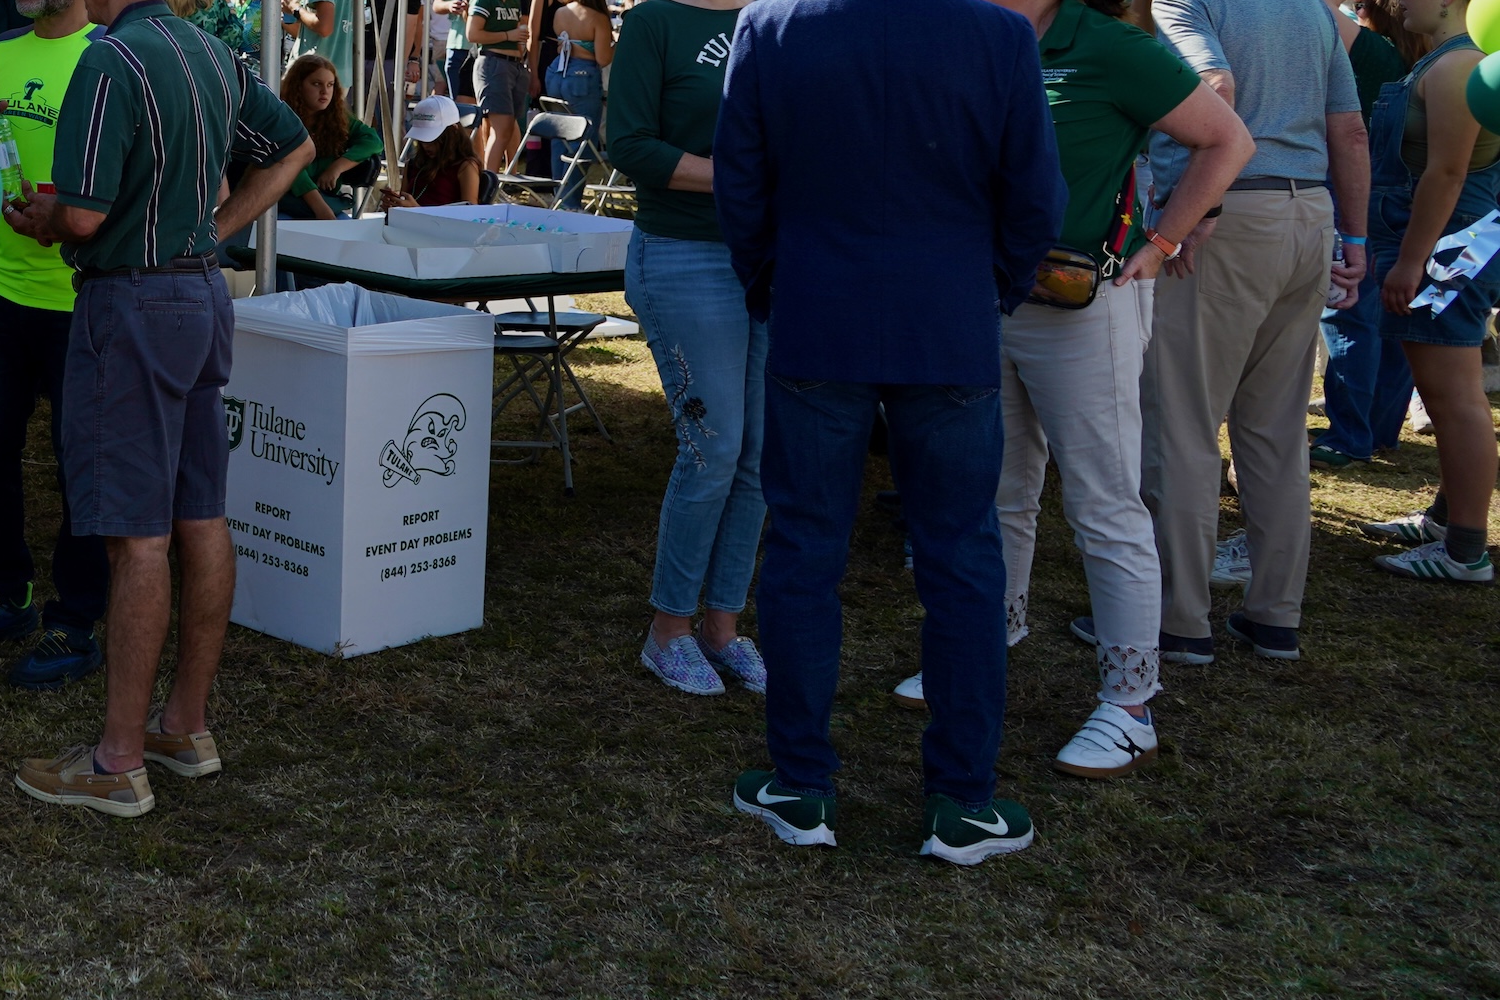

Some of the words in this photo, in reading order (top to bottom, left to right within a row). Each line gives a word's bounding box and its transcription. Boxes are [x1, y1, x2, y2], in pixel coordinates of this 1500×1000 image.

[6, 99, 60, 120] ULANE
[249, 401, 306, 440] Tulane
[250, 429, 340, 486] University
[386, 449, 413, 477] TULANE
[255, 501, 291, 521] REPORT
[402, 509, 440, 526] REPORT
[226, 517, 250, 534] VENT
[252, 525, 272, 540] DAY
[274, 531, 326, 557] PROBLEMS
[365, 542, 397, 557] EVENT
[400, 538, 420, 552] DAY
[422, 528, 472, 547] PROBLEMS
[234, 544, 260, 564] (844)
[262, 552, 309, 577] 253-8368
[380, 564, 407, 582] (844)
[410, 554, 457, 574] 253-8368
